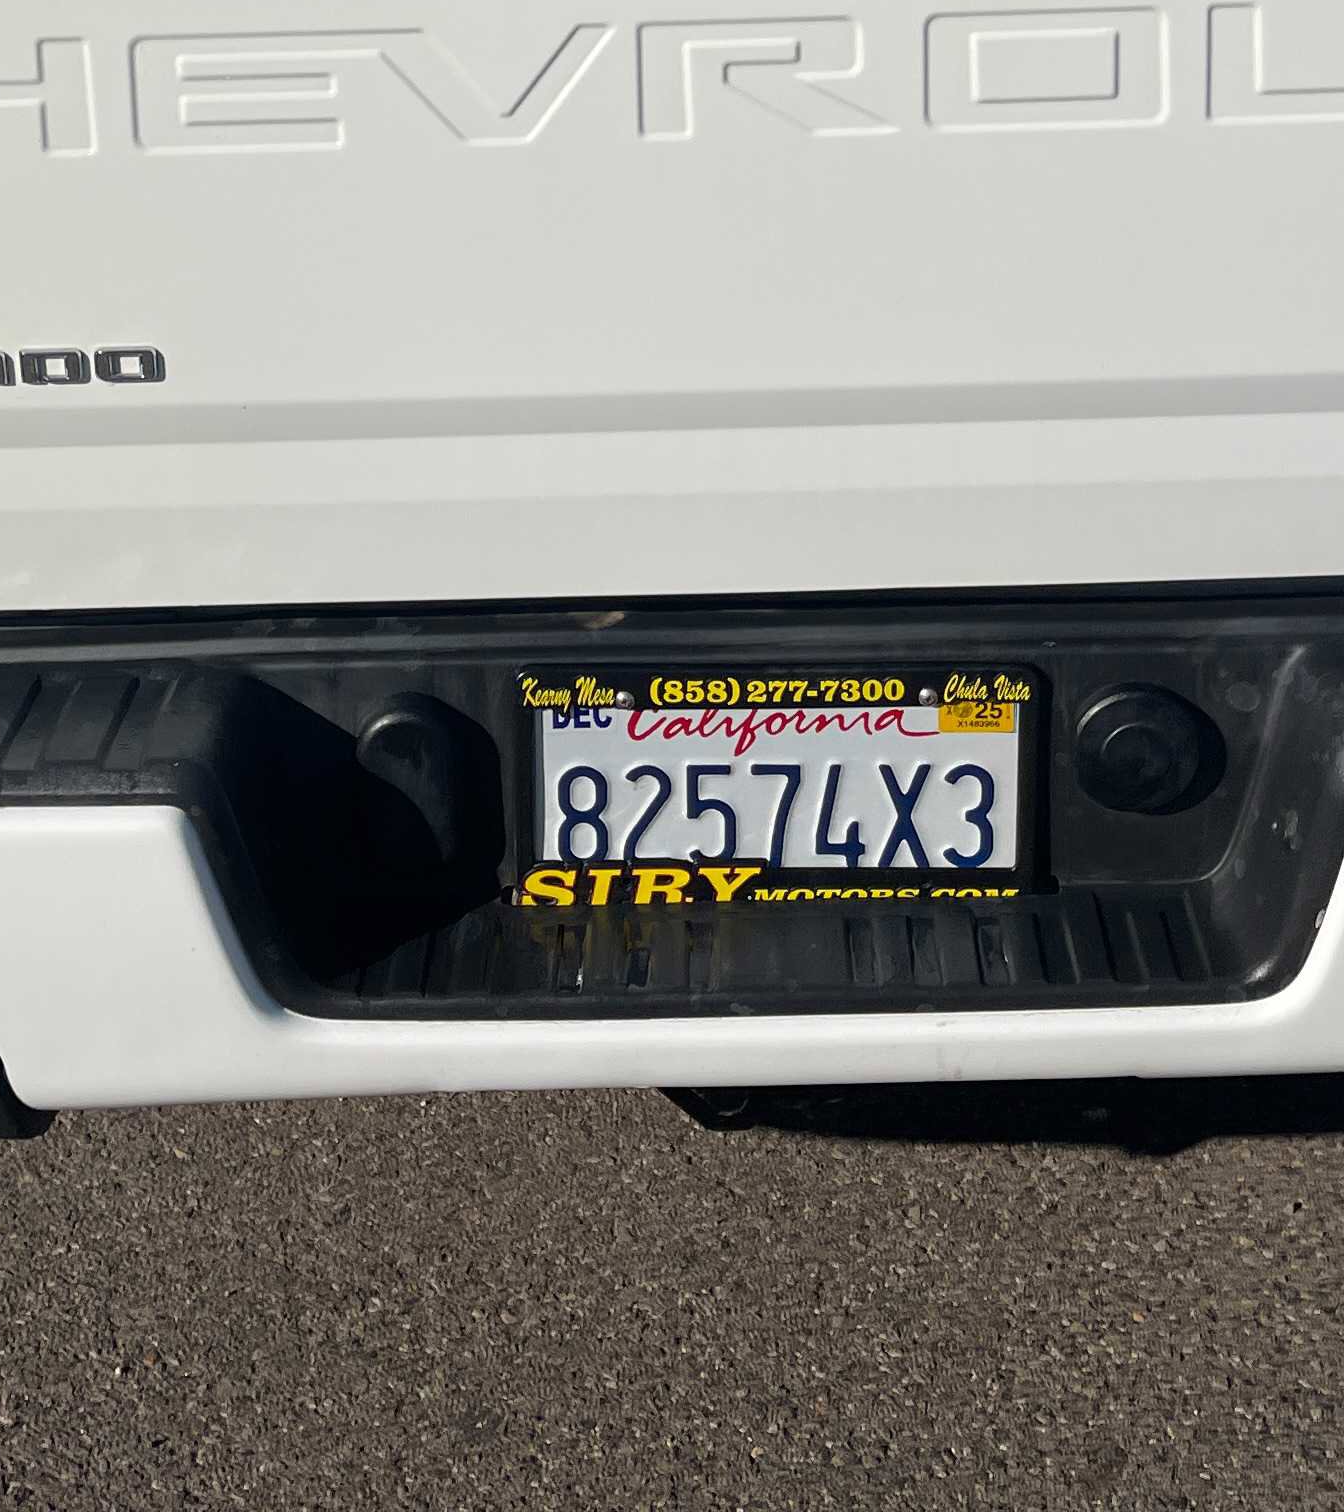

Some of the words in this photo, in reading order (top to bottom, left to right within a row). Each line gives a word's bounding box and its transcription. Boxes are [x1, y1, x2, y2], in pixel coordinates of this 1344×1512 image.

[521, 676, 572, 712] Kearny
[575, 676, 616, 706] Mesa
[649, 676, 741, 706] (858)
[746, 678, 906, 704] 277-7300
[943, 674, 989, 702] Chula
[994, 673, 1032, 702] Vista
[975, 701, 1003, 719] 25
[627, 707, 940, 757] California
[556, 762, 996, 868] 82574X3
[520, 866, 761, 906] SIRY
